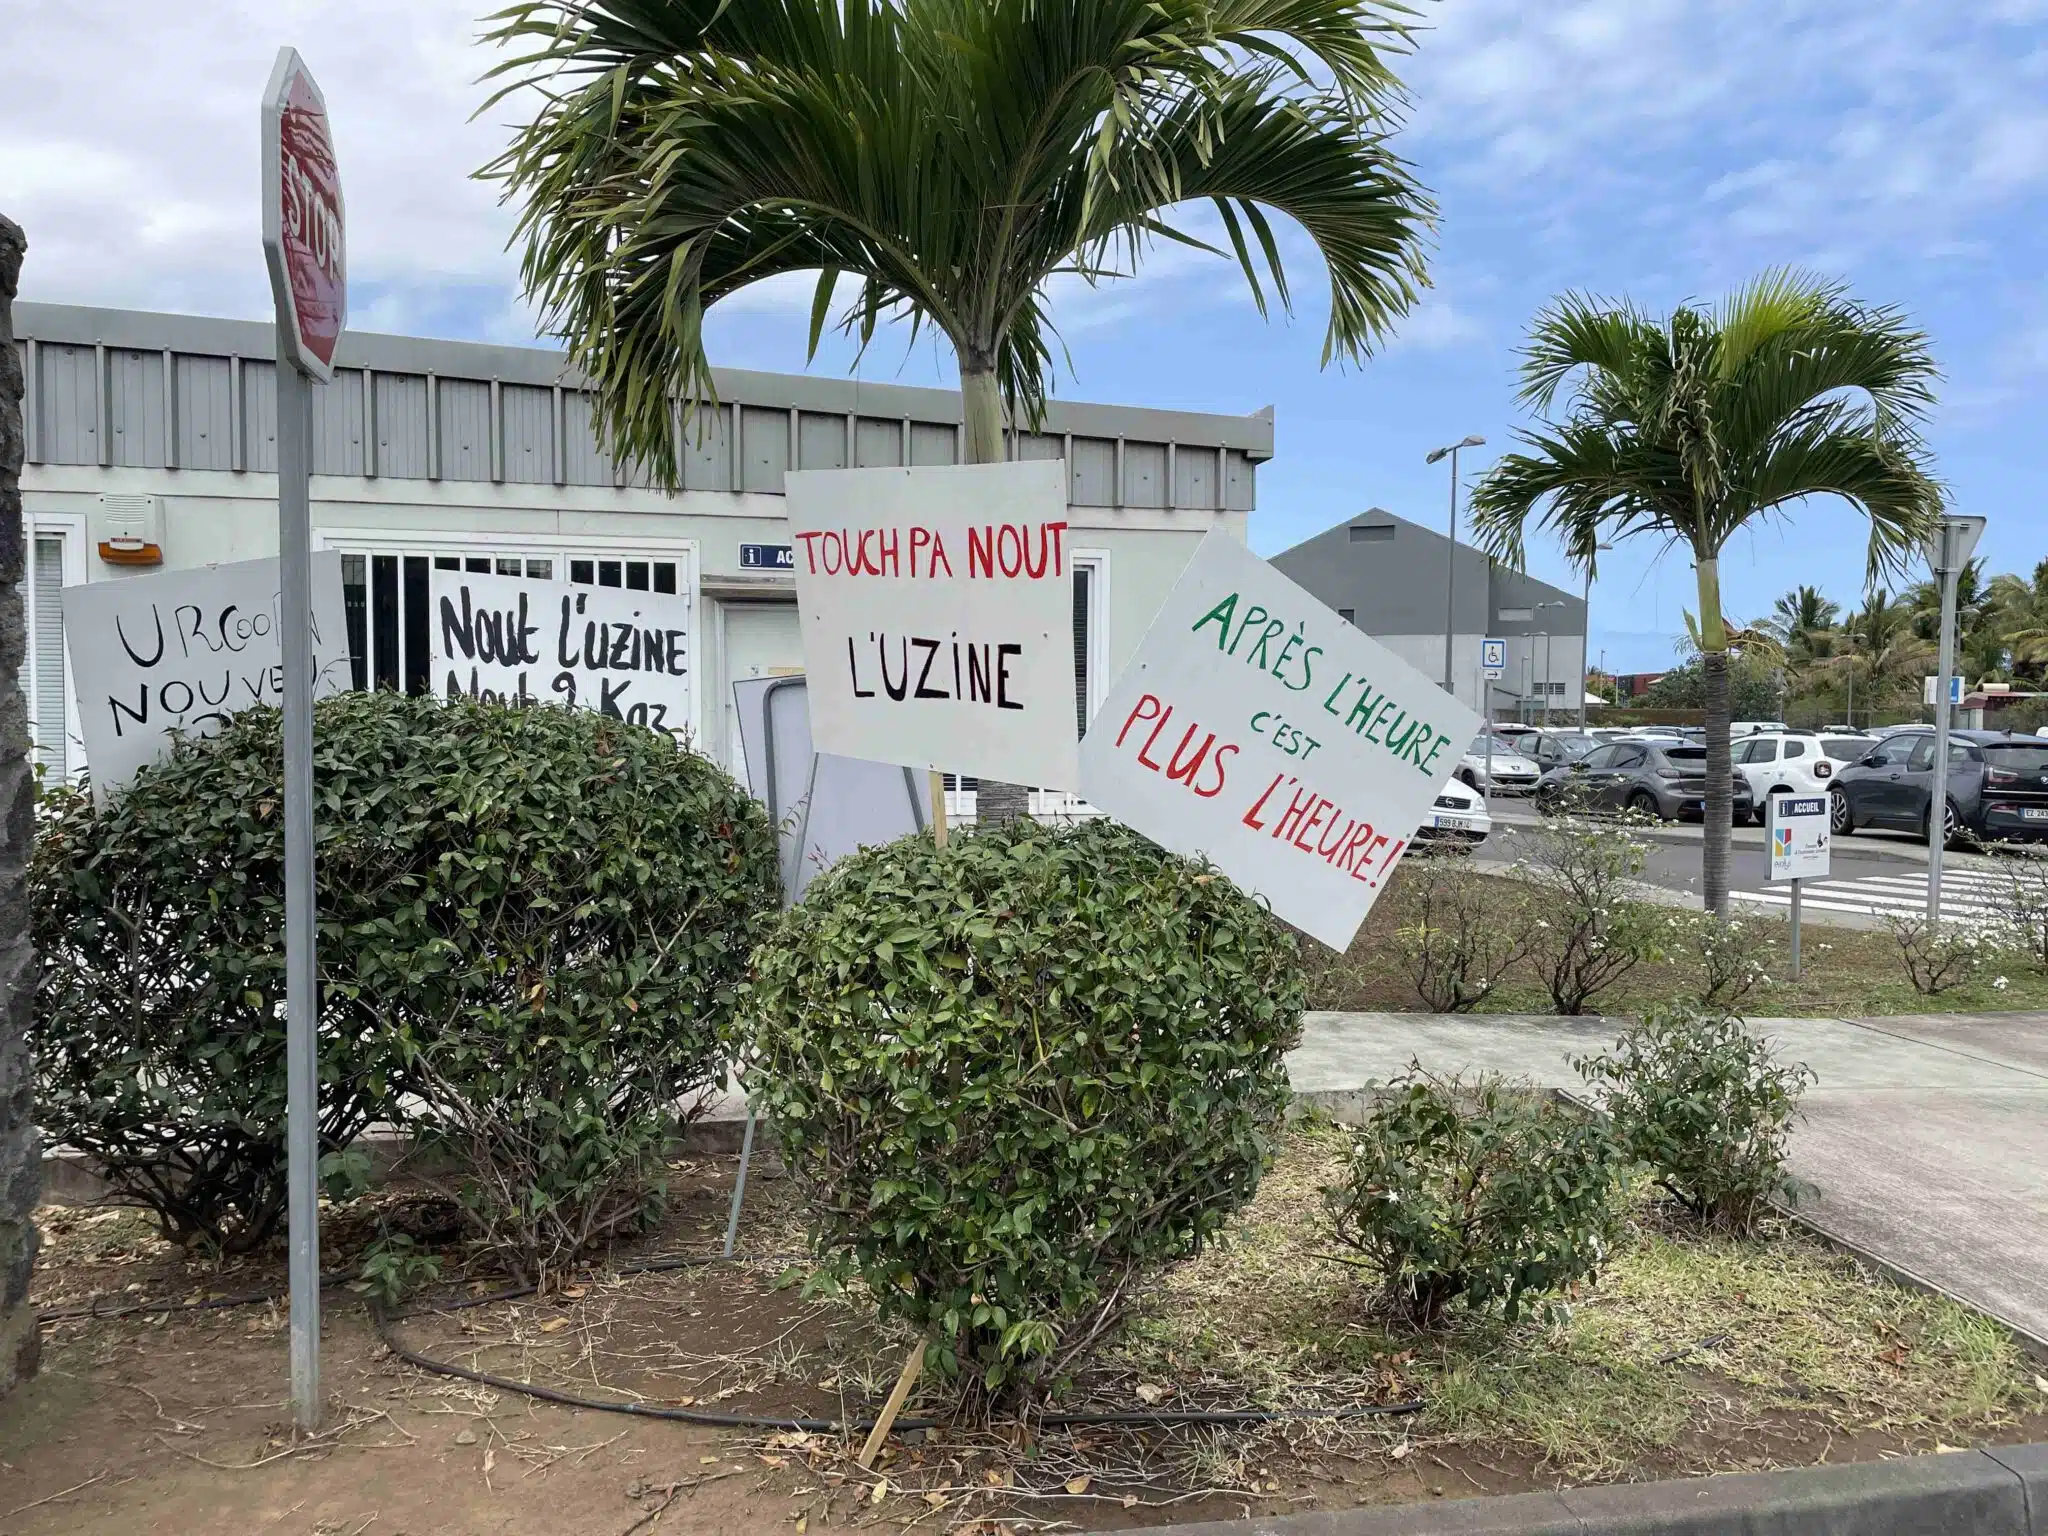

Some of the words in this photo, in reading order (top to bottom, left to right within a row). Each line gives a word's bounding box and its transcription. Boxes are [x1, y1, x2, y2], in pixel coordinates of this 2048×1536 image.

[288, 155, 340, 281] STOP
[795, 528, 899, 578] TOUCH
[909, 526, 953, 579] PA
[968, 521, 1068, 579] NOUT
[1191, 592, 1324, 691] APRÈS
[1323, 671, 1452, 778] L'HEURE
[1250, 710, 1322, 761] C'EST
[1115, 693, 1240, 798] PLUS
[1242, 772, 1406, 888] L'HEURE!
[1794, 802, 1820, 813] ACCUEIL
